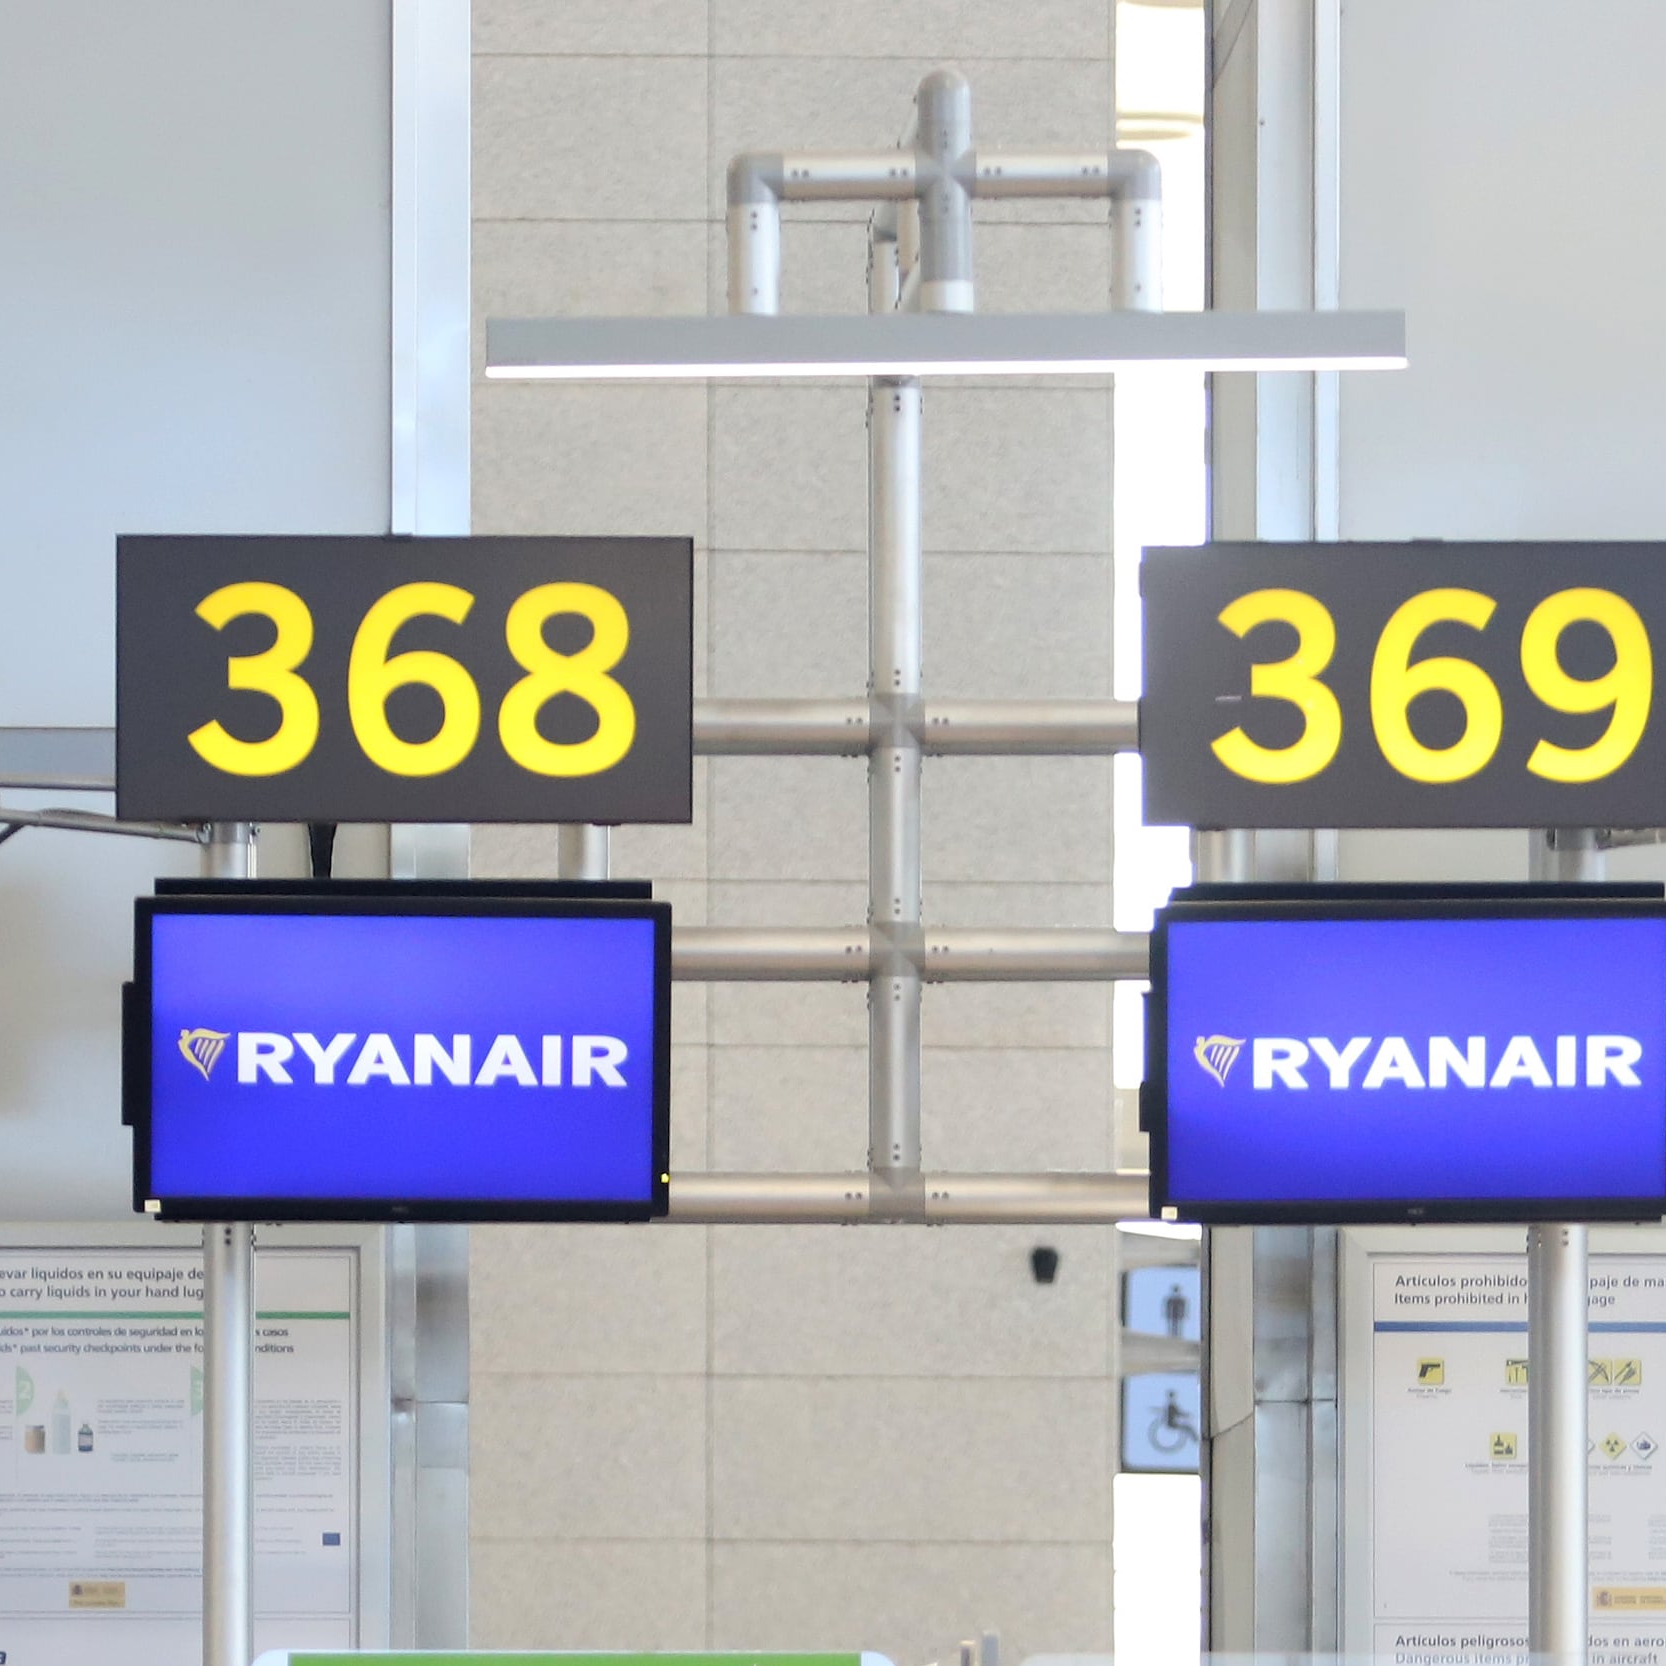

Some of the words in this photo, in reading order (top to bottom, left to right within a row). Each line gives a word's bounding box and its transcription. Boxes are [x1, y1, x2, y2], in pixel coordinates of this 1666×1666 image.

[187, 582, 637, 777] 368
[1211, 588, 1654, 784] 369
[238, 1032, 628, 1087] RYANAIR
[1253, 1035, 1642, 1089] RYANAIR
[88, 1271, 103, 1279] en
[108, 1271, 122, 1279] su
[127, 1268, 183, 1282] equipaje
[188, 1268, 203, 1279] de
[1461, 1275, 1527, 1289] prohibido
[1623, 1276, 1639, 1287] de
[10, 1288, 42, 1300] carry
[47, 1285, 90, 1300] liquids
[95, 1286, 106, 1297] in
[111, 1289, 141, 1300] your
[146, 1286, 179, 1297] hand
[1395, 1293, 1430, 1304] Items
[1435, 1293, 1503, 1307] prohibited
[1508, 1293, 1519, 1304] in
[1613, 1638, 1629, 1647] en
[1593, 1654, 1604, 1664] in
[1610, 1652, 1657, 1664] aircraft
